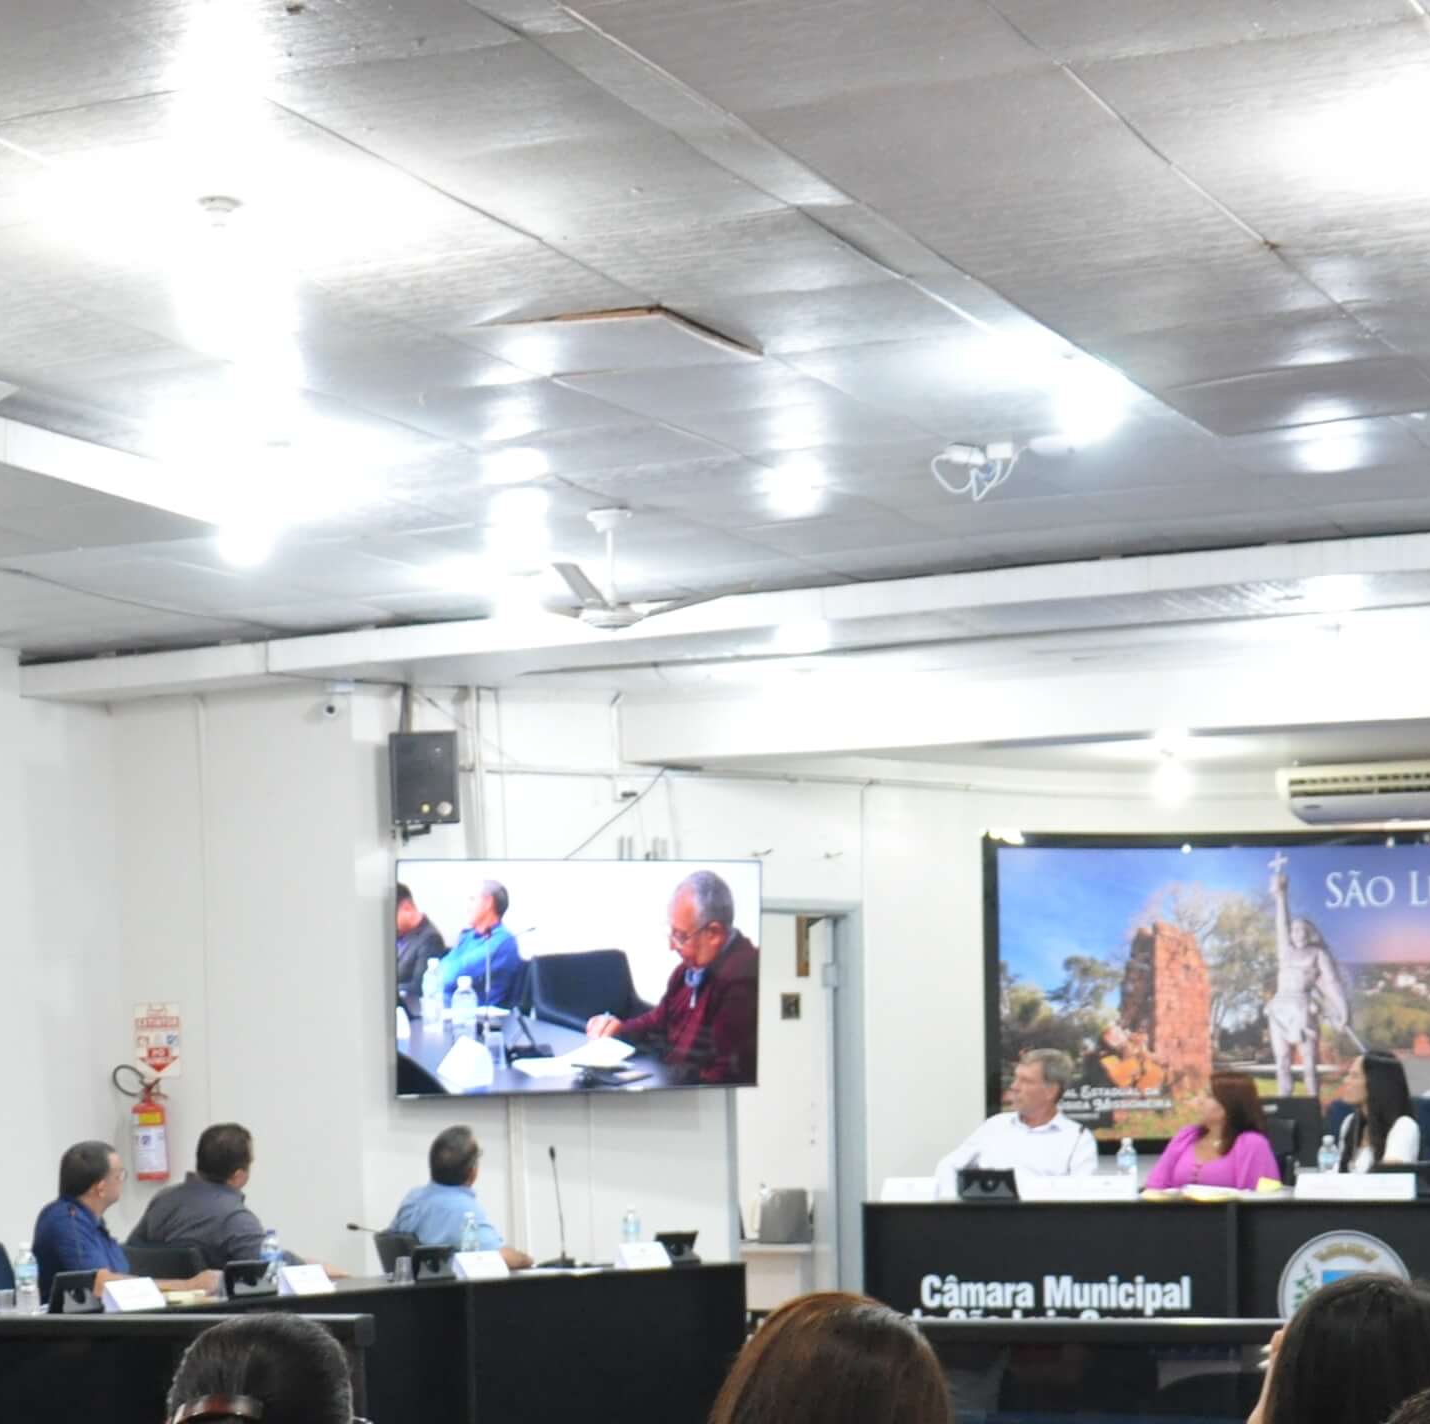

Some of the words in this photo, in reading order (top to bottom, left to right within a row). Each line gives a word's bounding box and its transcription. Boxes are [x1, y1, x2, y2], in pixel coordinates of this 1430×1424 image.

[1325, 869, 1395, 908] SÃO
[921, 1273, 1035, 1309] Câmara
[1043, 1275, 1191, 1317] Municipal
